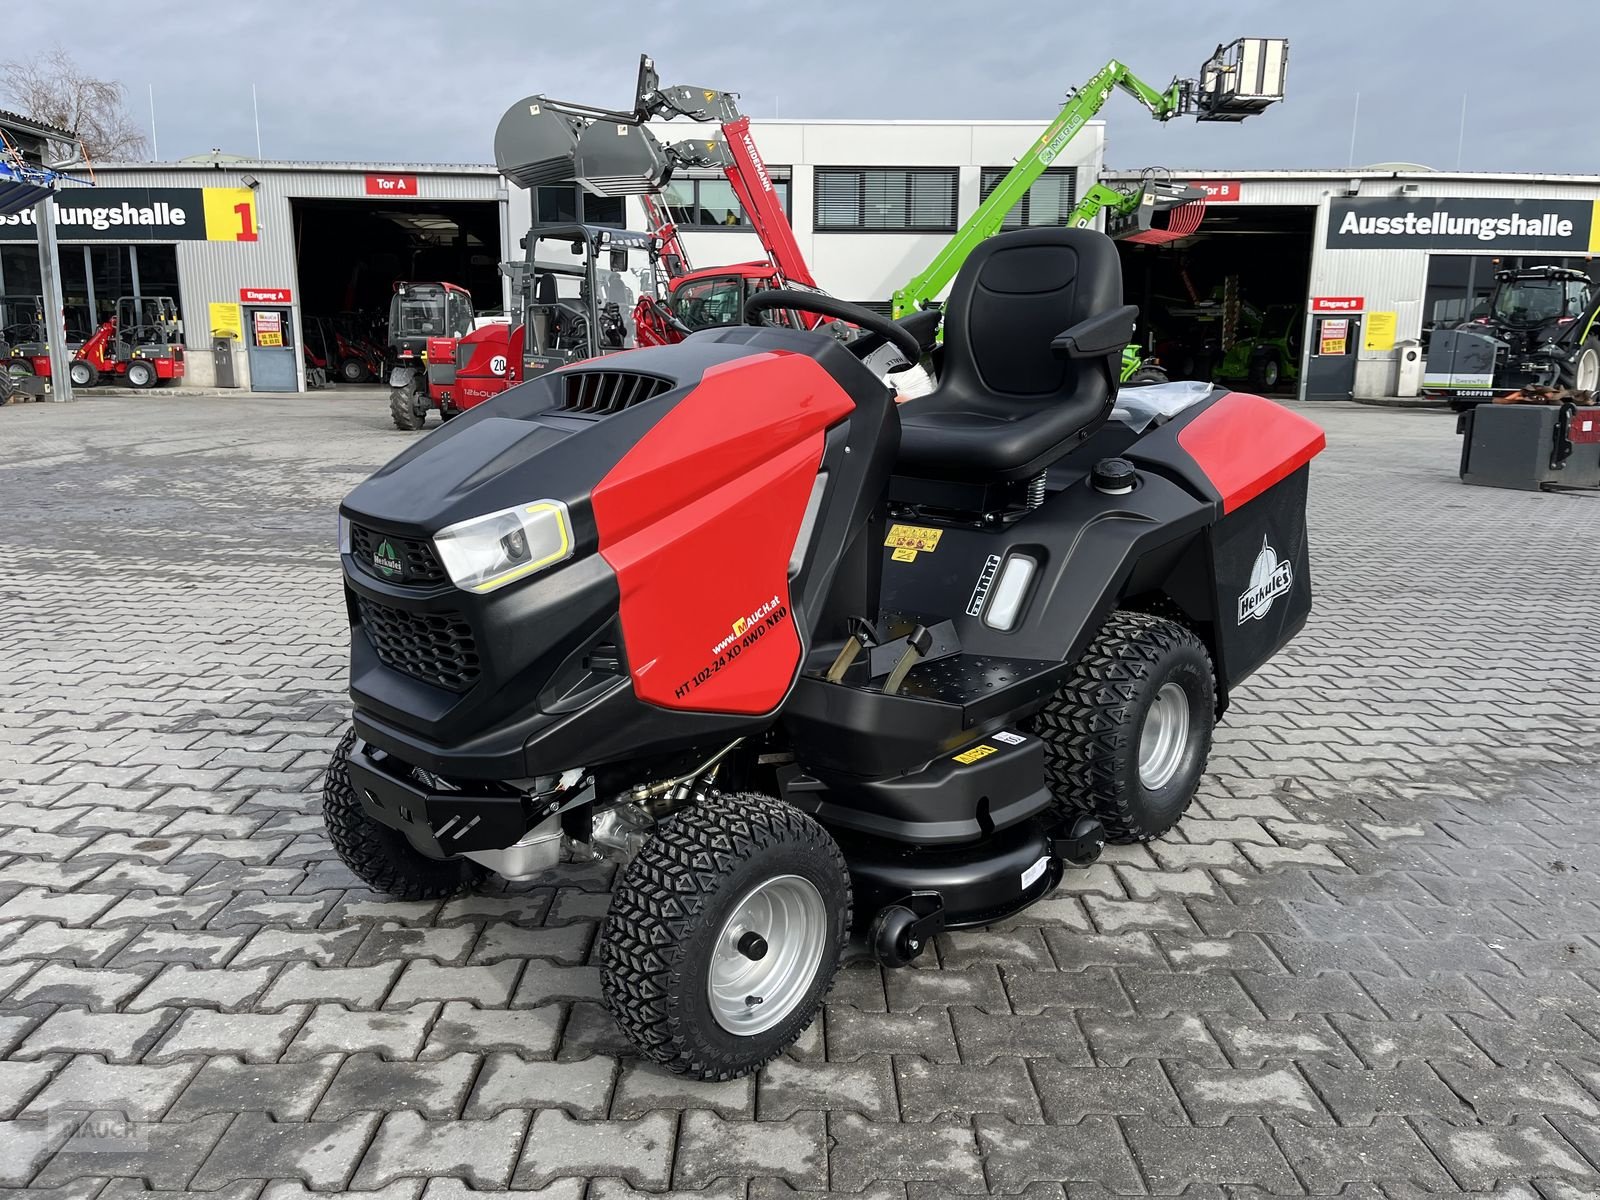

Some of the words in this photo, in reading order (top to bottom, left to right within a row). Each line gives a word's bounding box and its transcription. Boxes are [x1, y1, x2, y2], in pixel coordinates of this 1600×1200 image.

[1051, 115, 1081, 149] MERLO
[743, 134, 772, 192] WEIDEMANN
[376, 178, 395, 189] Tor
[397, 178, 406, 189] A
[1221, 185, 1229, 195] B
[234, 202, 258, 242] 1
[1339, 211, 1573, 241] Ausstellungshalle
[247, 291, 277, 300] Eingang
[277, 291, 284, 299] A
[1320, 300, 1349, 309] Eingang
[494, 359, 506, 371] 20
[1241, 571, 1290, 617] Herkules
[712, 595, 780, 655] www.MAUCH.at
[674, 682, 692, 699] HT
[692, 656, 726, 687] 102-24
[725, 644, 742, 662] XD
[742, 625, 766, 649] 4WD
[764, 606, 787, 630] NEO
